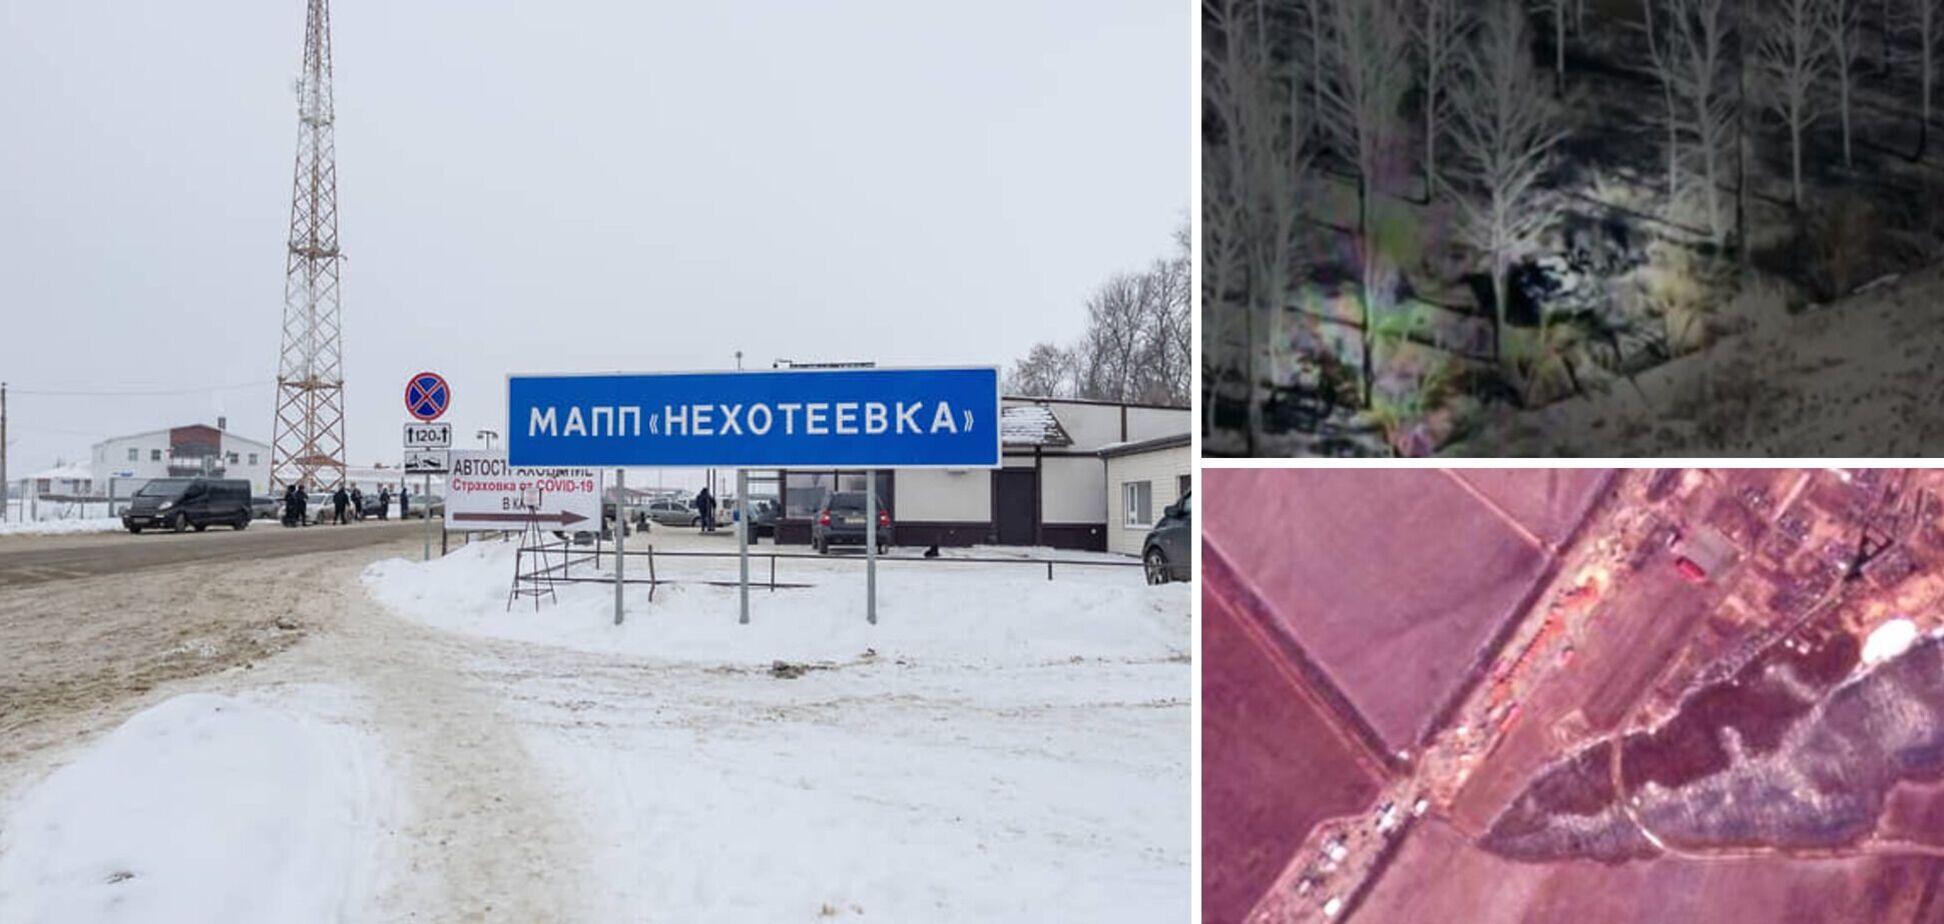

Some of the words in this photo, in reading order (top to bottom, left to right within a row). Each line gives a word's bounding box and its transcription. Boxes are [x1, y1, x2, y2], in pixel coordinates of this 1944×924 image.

[528, 406, 641, 438] МАПП
[648, 401, 975, 437] «НЕХОТЕЕВКА»
[453, 478, 516, 493] Страховка
[536, 479, 593, 493] COVID-19
